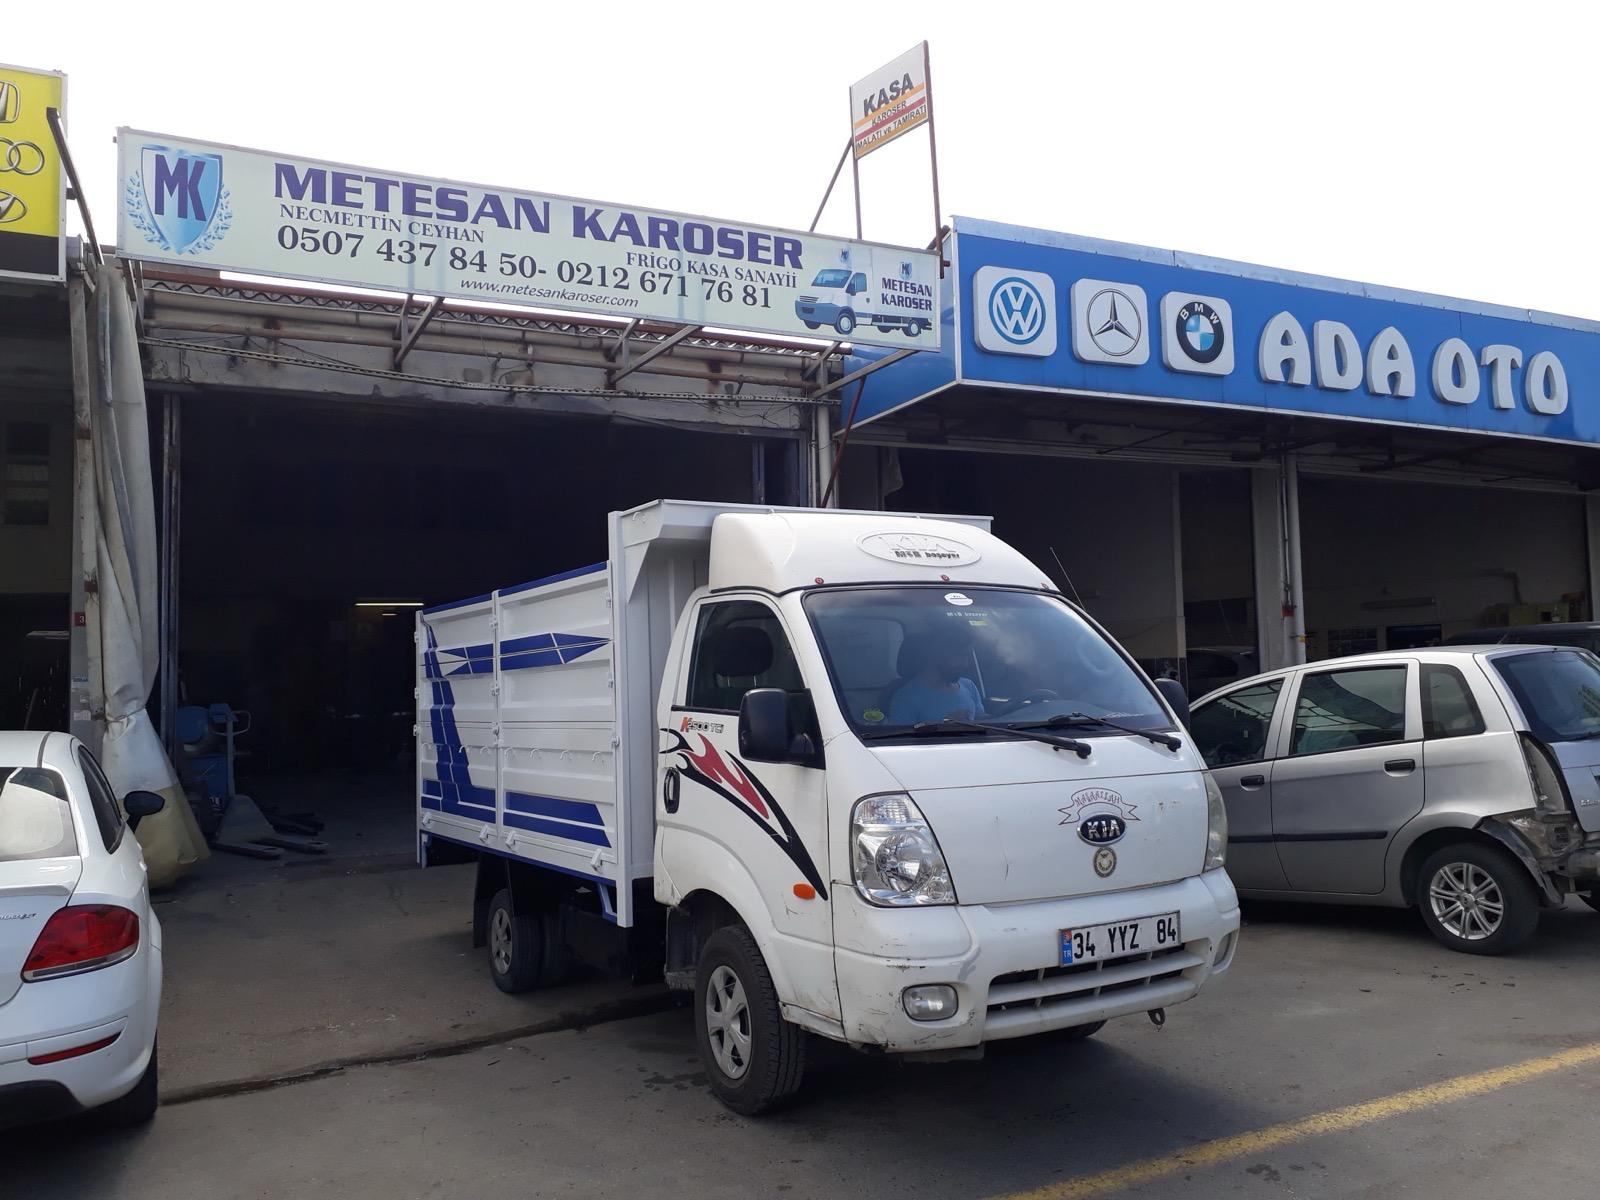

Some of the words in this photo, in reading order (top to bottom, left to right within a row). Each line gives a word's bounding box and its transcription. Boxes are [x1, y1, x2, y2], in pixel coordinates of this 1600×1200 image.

[863, 72, 915, 117] KASA
[872, 100, 907, 126] KAROSER
[154, 153, 207, 222] MK
[274, 162, 551, 234] METESAN
[572, 205, 804, 270] KAROSER
[279, 203, 402, 233] NECMETTİN
[407, 221, 485, 244] CEYHAN
[277, 225, 365, 258] 0507
[376, 238, 438, 267] 437
[449, 246, 488, 273] 84
[557, 259, 630, 290] 0212
[639, 270, 689, 298] 671
[701, 278, 734, 303] 76
[742, 284, 772, 309] 81
[626, 251, 683, 272] FRİGO
[687, 260, 730, 279] KASA
[460, 278, 639, 308] www.metesankaroser.com
[881, 277, 933, 298] METESAN
[881, 293, 933, 312] KAROSER
[1179, 302, 1220, 325] BMW
[1258, 310, 1417, 398] ADA
[1432, 336, 1569, 415] OTO
[1086, 818, 1121, 840] KIA
[1073, 931, 1096, 959] 34
[1107, 923, 1139, 953] YYZ
[1156, 917, 1177, 945] 84
[1063, 949, 1072, 958] TR
